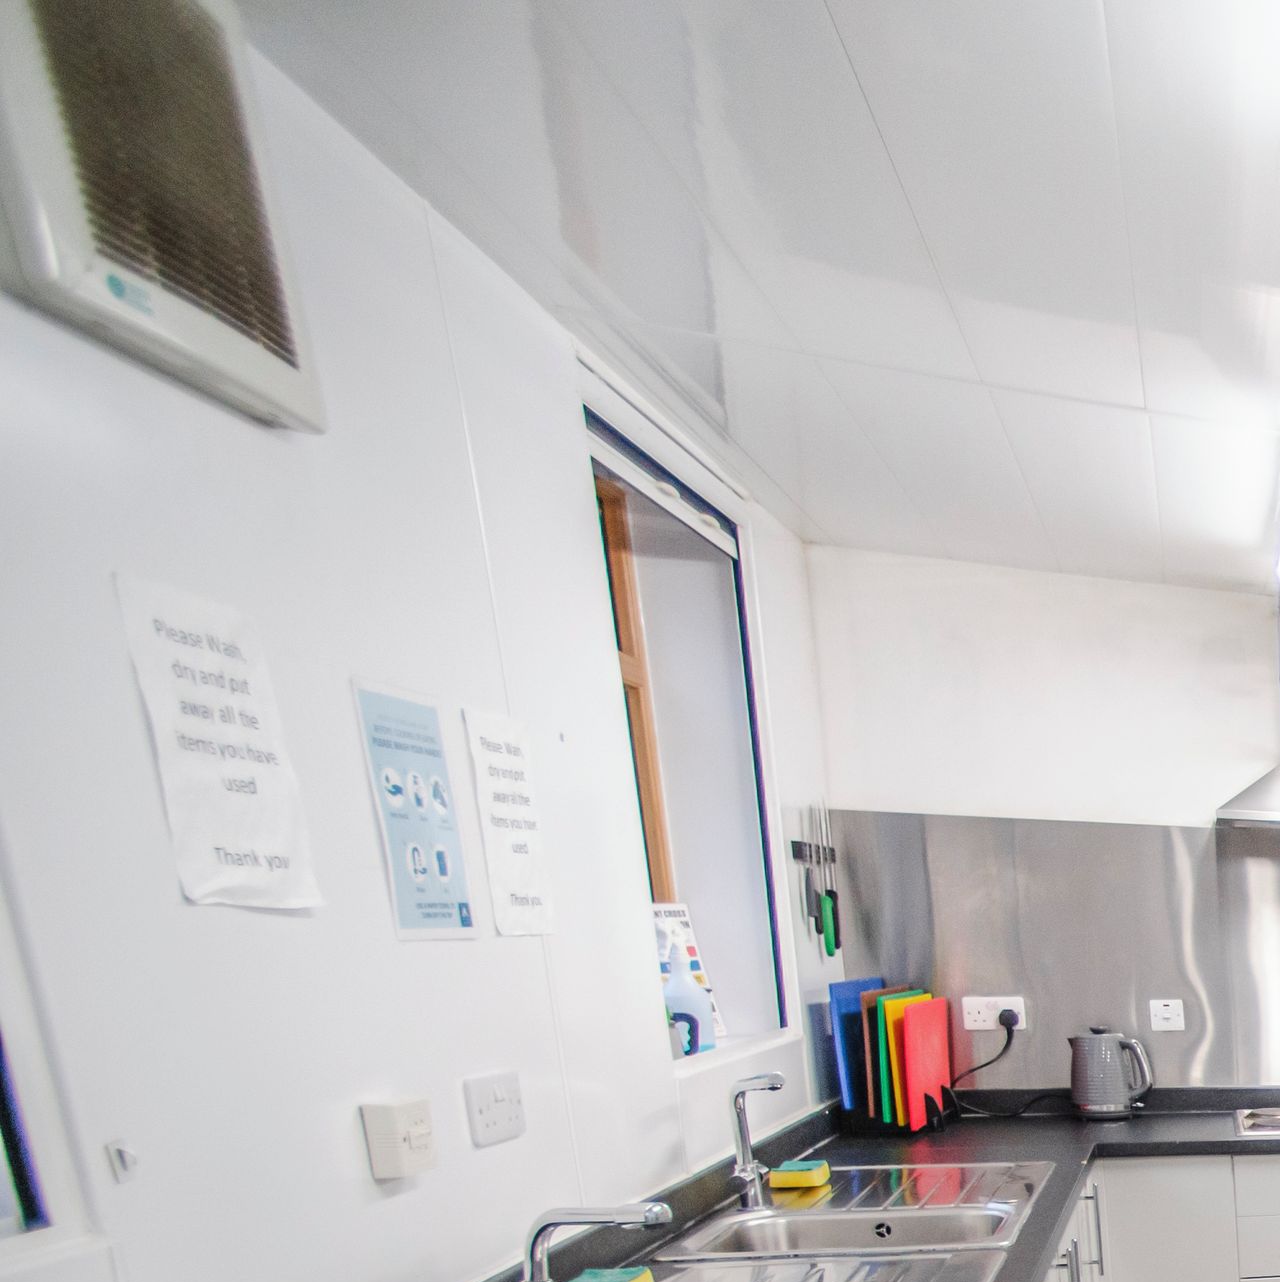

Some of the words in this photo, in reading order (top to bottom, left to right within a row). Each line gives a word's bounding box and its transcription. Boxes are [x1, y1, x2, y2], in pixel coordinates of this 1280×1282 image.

[152, 617, 203, 649] Please
[171, 658, 198, 684] dry
[200, 667, 225, 689] and
[229, 675, 252, 696] put
[218, 704, 236, 725] all
[239, 710, 260, 731] the
[175, 730, 217, 755] items
[218, 741, 246, 763] you
[246, 743, 280, 766] have
[222, 775, 259, 796] used
[213, 846, 261, 868] Thank
[263, 853, 291, 872] you
[510, 892, 530, 907] Thank
